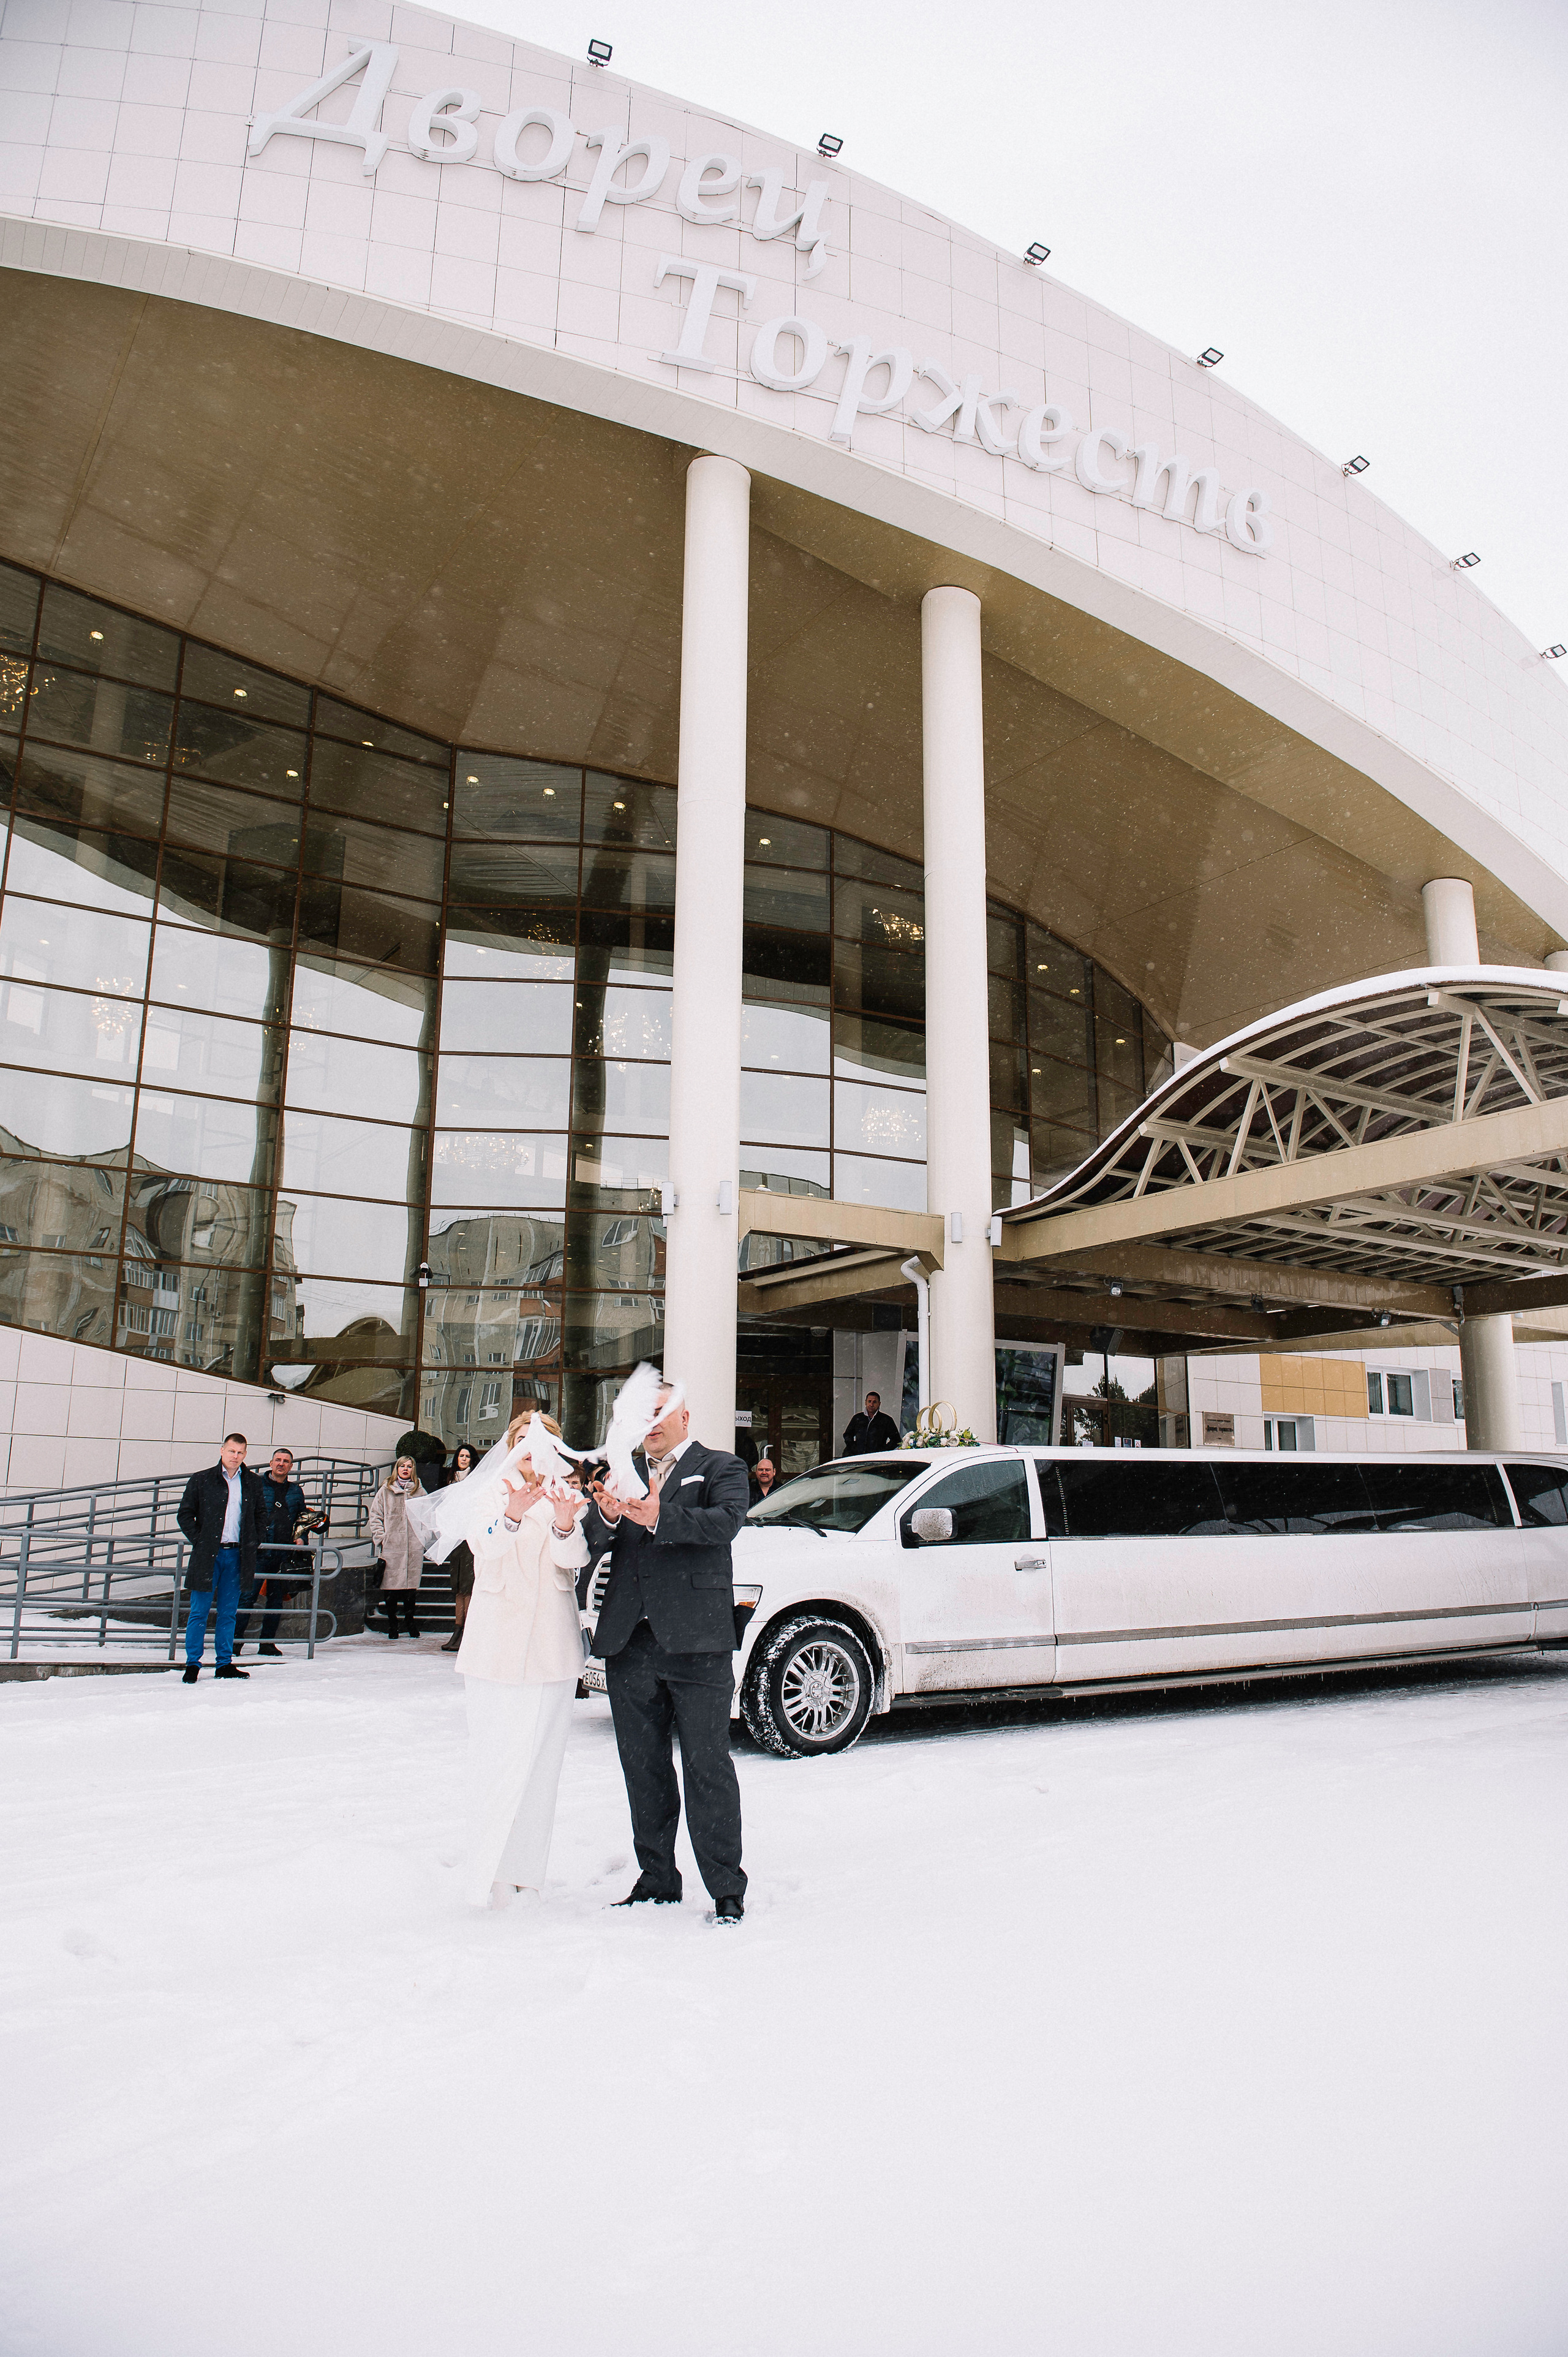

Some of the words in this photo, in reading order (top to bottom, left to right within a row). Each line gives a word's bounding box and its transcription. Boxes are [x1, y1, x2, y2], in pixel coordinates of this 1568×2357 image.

[247, 37, 831, 281] Дворец
[653, 252, 1275, 554] Торжеств
[585, 1671, 605, 1688] Е056Х
